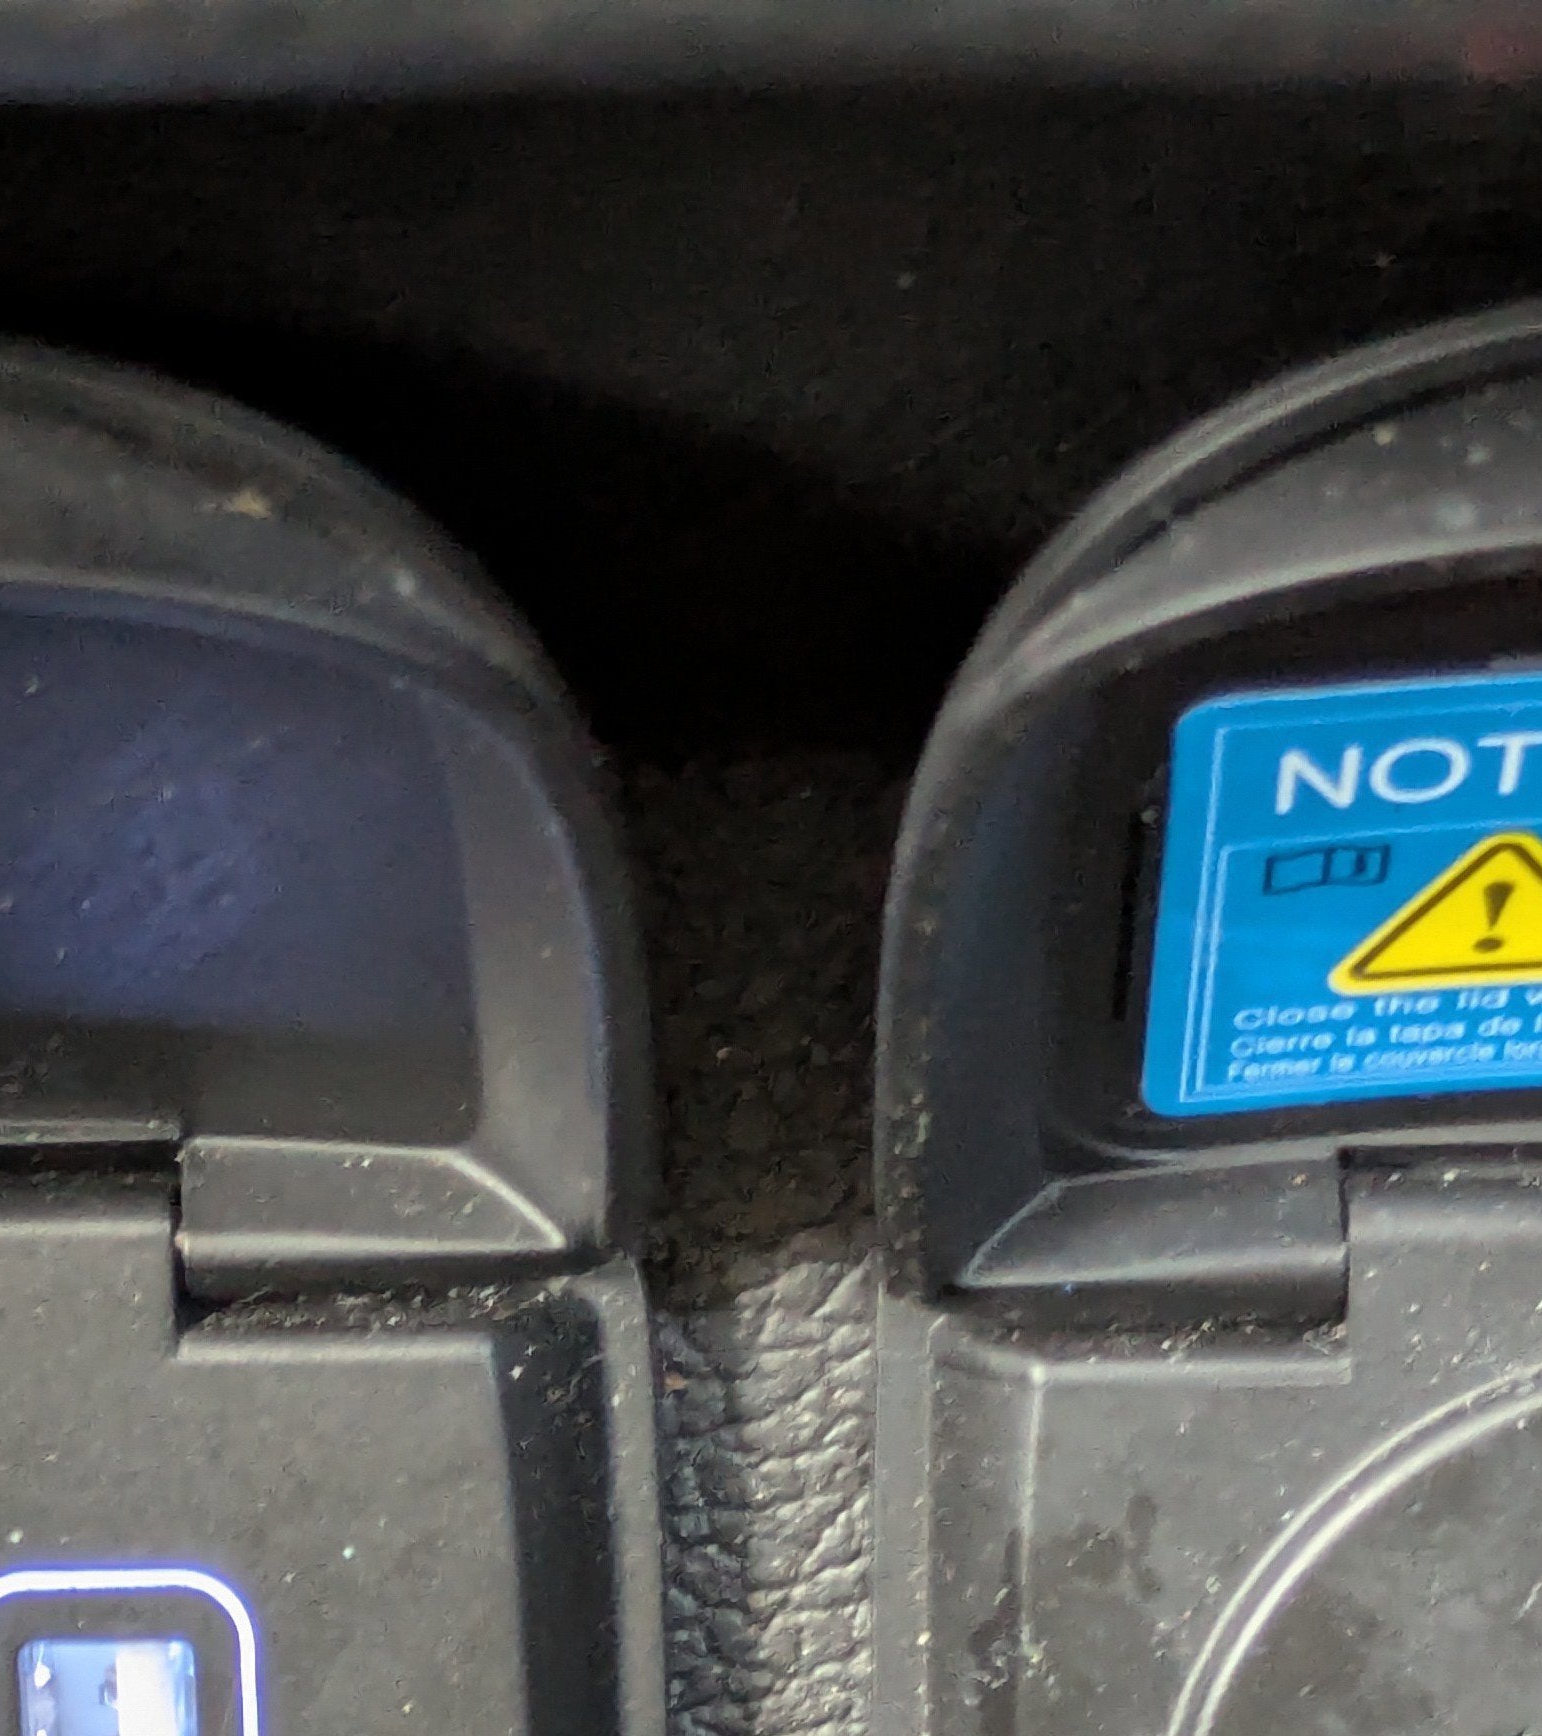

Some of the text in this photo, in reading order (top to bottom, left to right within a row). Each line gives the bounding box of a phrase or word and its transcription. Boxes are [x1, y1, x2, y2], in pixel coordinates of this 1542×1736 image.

[1234, 1001, 1357, 1030] Close
[1374, 995, 1440, 1016] the
[1456, 988, 1511, 1010] lid
[1230, 1032, 1336, 1059] Cierre
[1346, 1026, 1378, 1047] la
[1389, 1022, 1466, 1044] tapa
[1477, 1016, 1523, 1038] de
